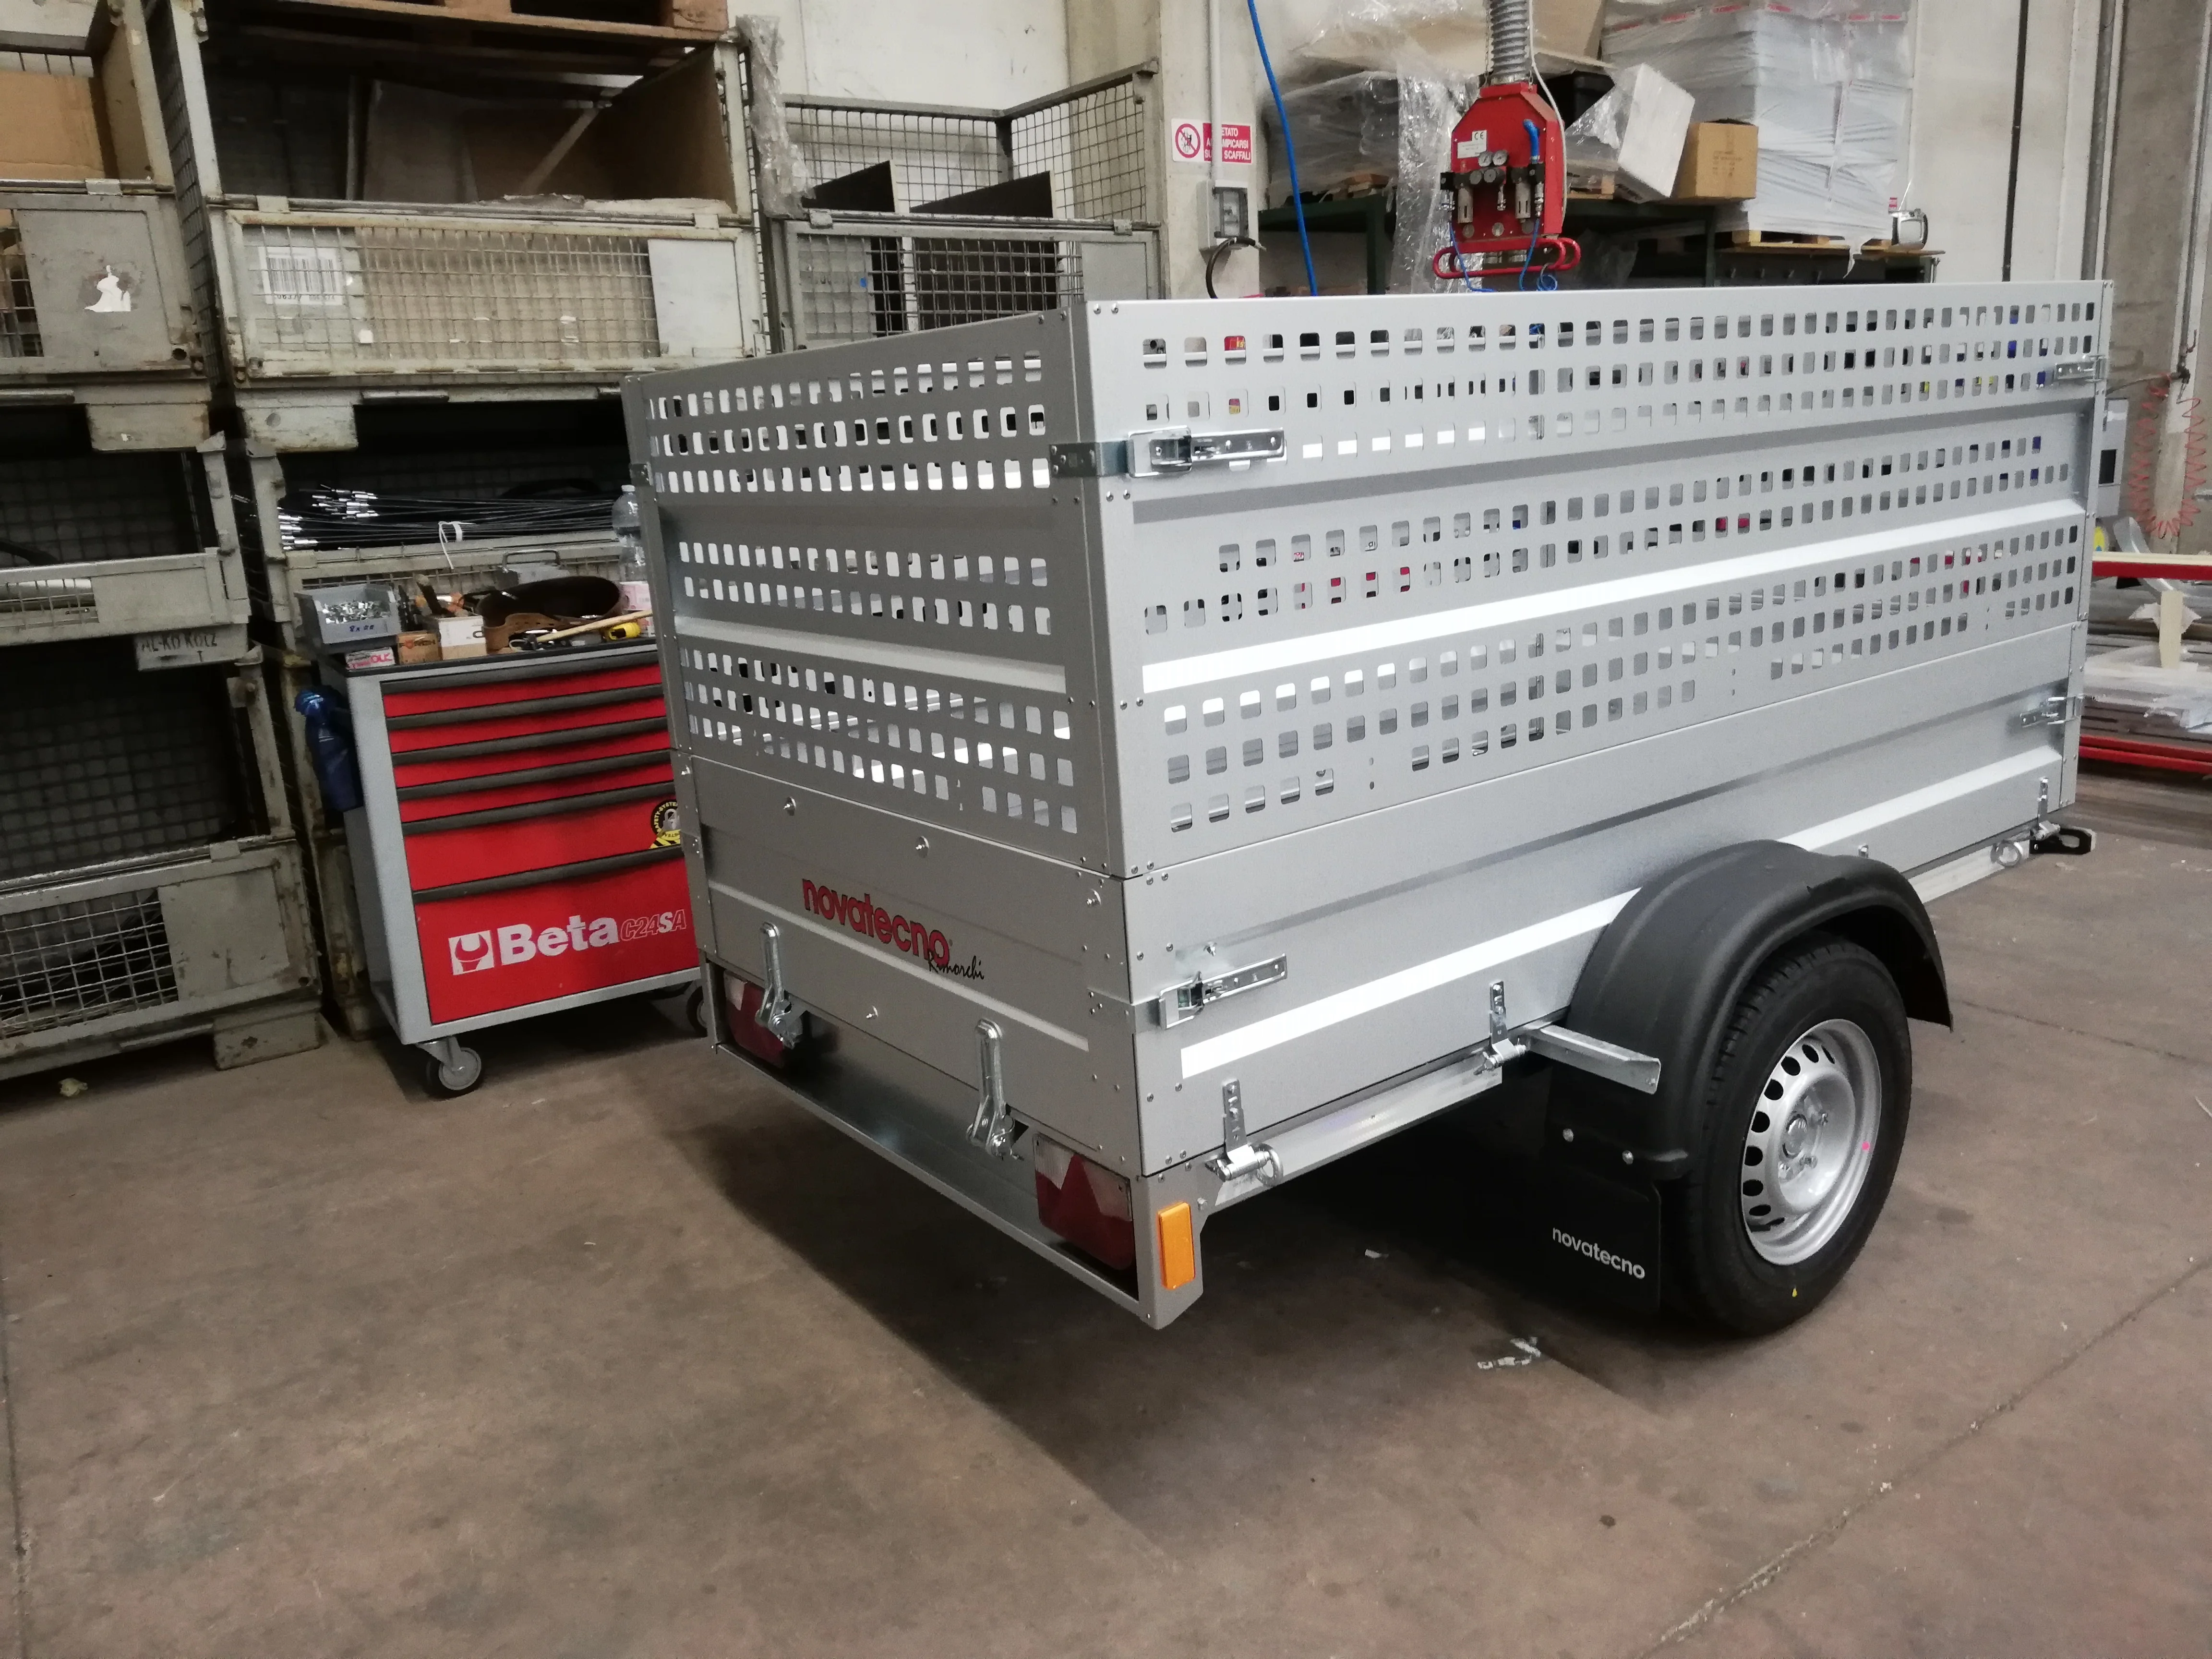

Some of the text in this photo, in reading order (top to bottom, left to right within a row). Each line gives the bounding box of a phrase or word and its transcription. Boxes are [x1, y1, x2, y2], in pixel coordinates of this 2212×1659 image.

[1221, 127, 1238, 137] ETATO
[1224, 150, 1250, 160] SCAFFALI
[497, 909, 687, 965] Beta C24SA
[802, 878, 950, 968] novatecno
[1552, 1227, 1645, 1279] novatecno
